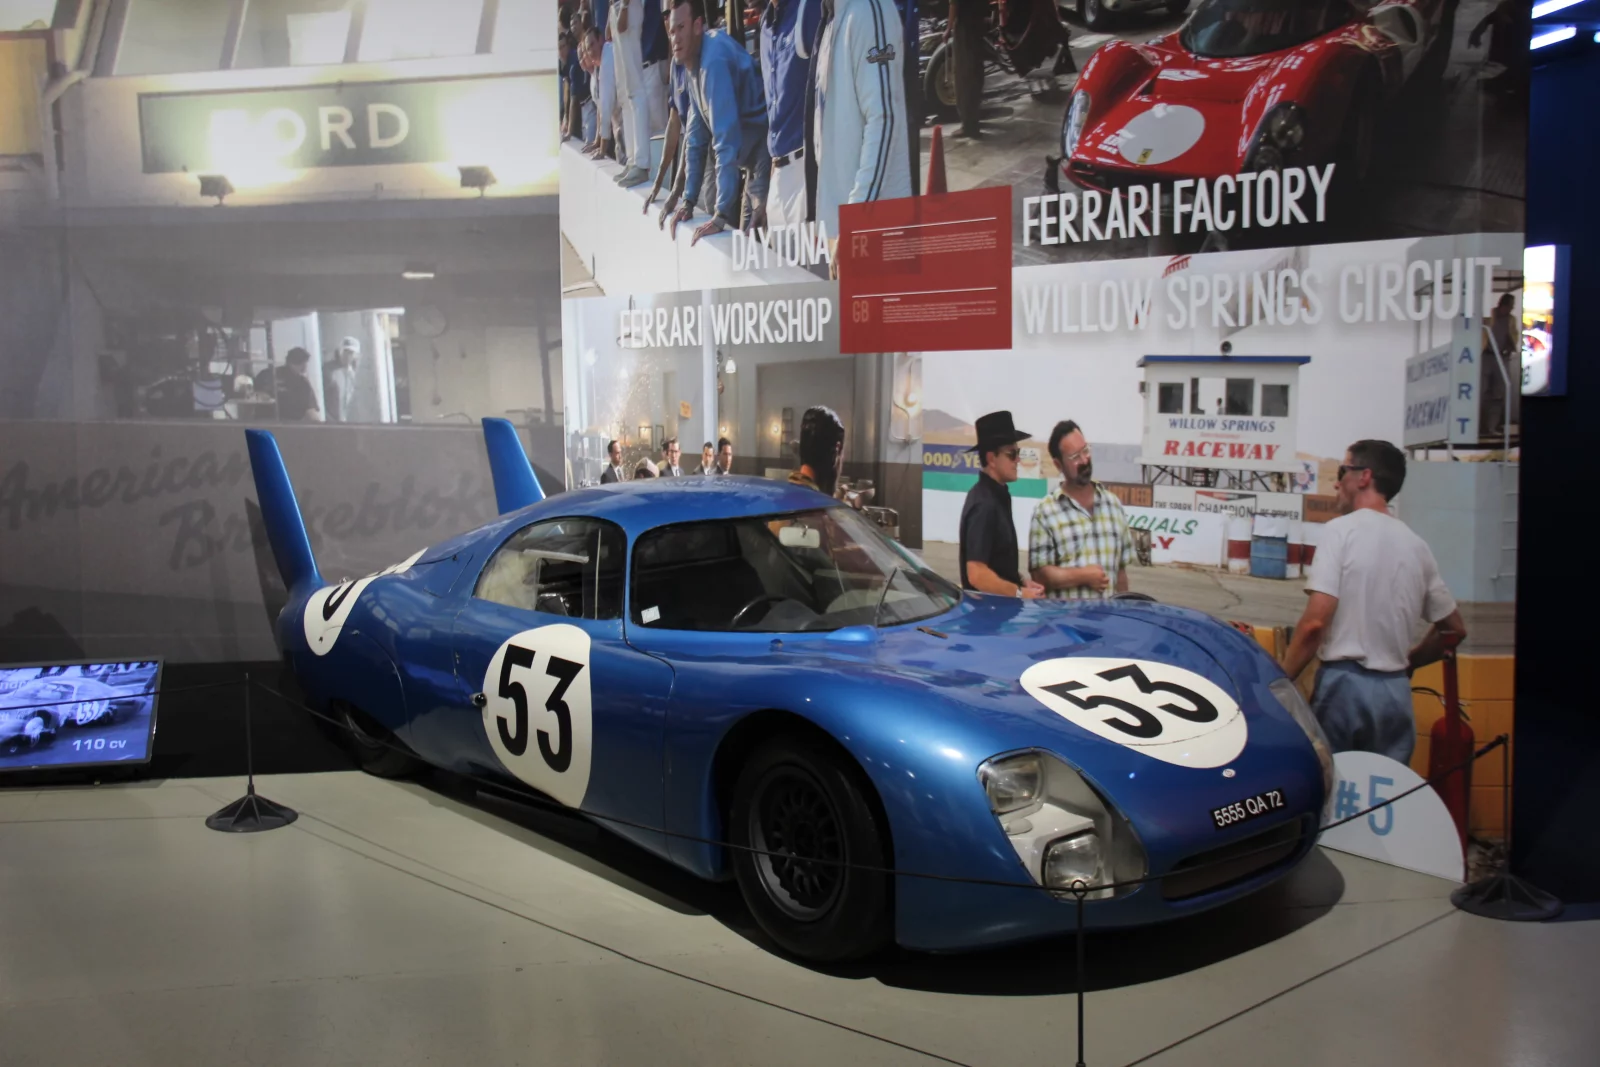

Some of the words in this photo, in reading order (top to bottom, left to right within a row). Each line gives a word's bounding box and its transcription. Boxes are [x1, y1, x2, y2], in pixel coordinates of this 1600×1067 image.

[1023, 182, 1160, 247] FERRARI
[1173, 163, 1336, 234] FACTORY
[731, 220, 830, 272] DAYTONA
[851, 235, 869, 258] FR
[852, 301, 869, 323] GB
[1020, 278, 1151, 334] WILLOW
[1166, 268, 1323, 330] SPRINGS
[1338, 257, 1503, 325] CIRCUIT
[619, 305, 703, 349] FERRARI
[710, 297, 832, 346] WORKSHOP
[1168, 418, 1217, 430] WILLOW
[1221, 419, 1276, 432] SPRINGS
[1163, 440, 1280, 460] RACEWAY
[1198, 502, 1253, 518] CHAMPION
[496, 643, 585, 773] 53
[1038, 664, 1219, 739] 53
[72, 739, 106, 751] 110
[1213, 802, 1247, 827] 5555
[1246, 796, 1268, 815] QA
[1266, 790, 1285, 808] 72
[1334, 775, 1394, 836] #5
